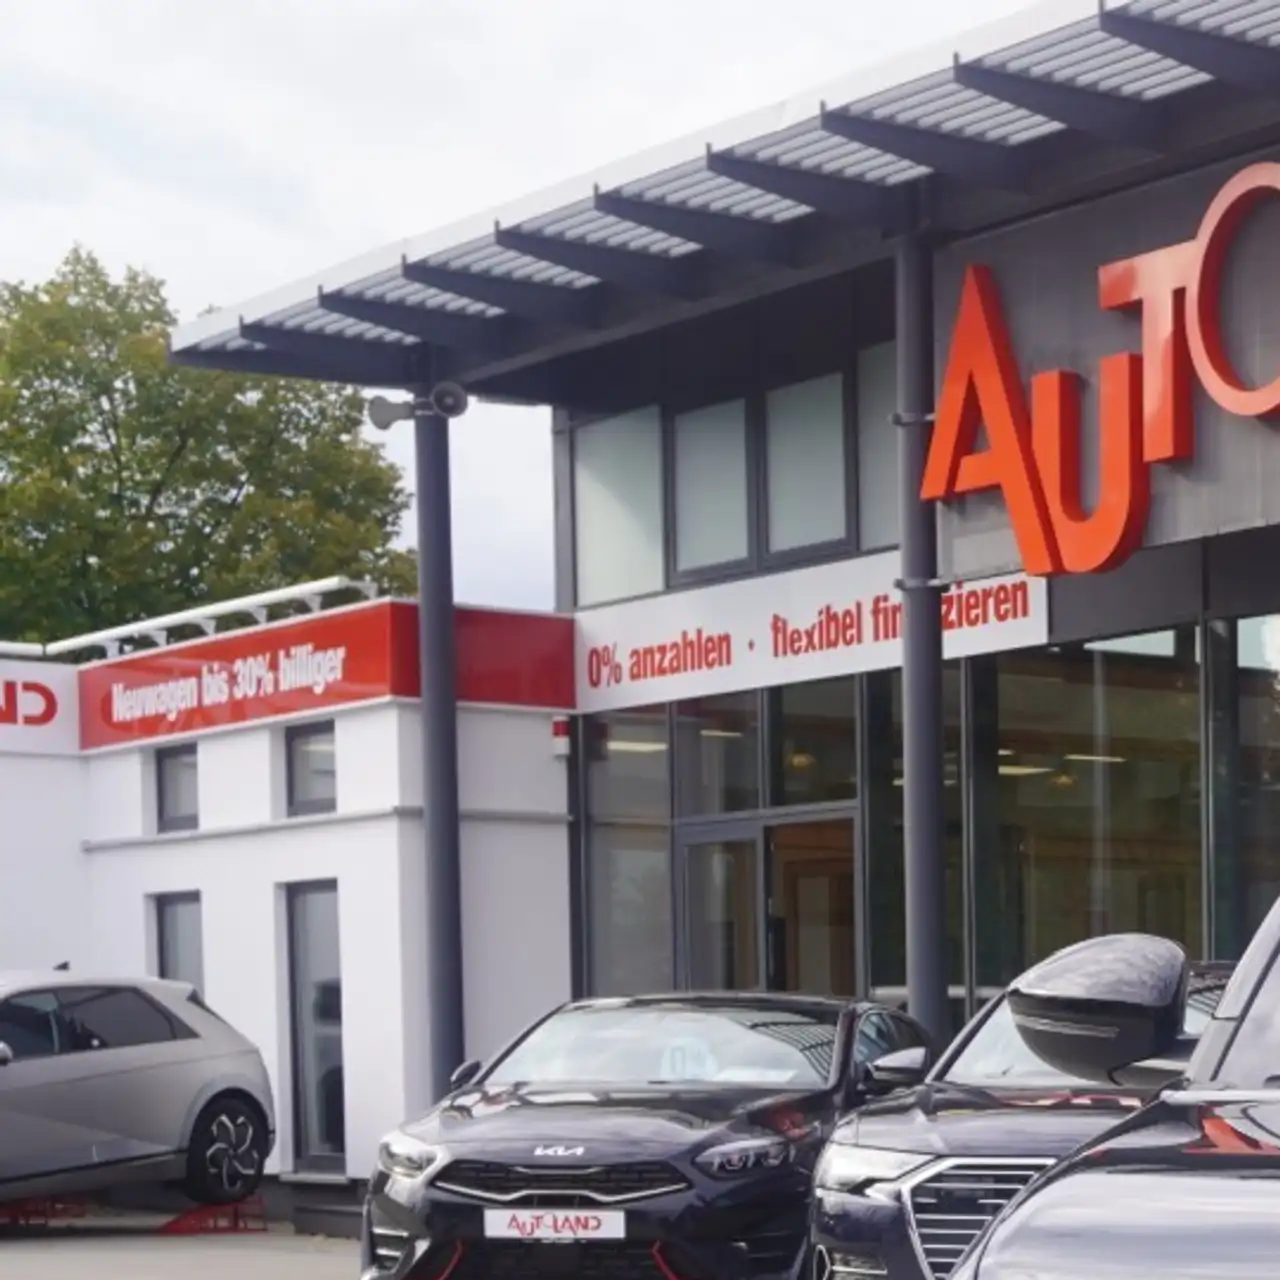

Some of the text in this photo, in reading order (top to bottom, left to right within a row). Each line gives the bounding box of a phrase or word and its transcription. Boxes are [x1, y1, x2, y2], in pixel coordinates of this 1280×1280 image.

[111, 643, 347, 723] Neuwagen bis 30% billiger
[588, 641, 622, 688] 0%
[629, 627, 732, 681] anzahlen
[770, 601, 863, 658] flexibel
